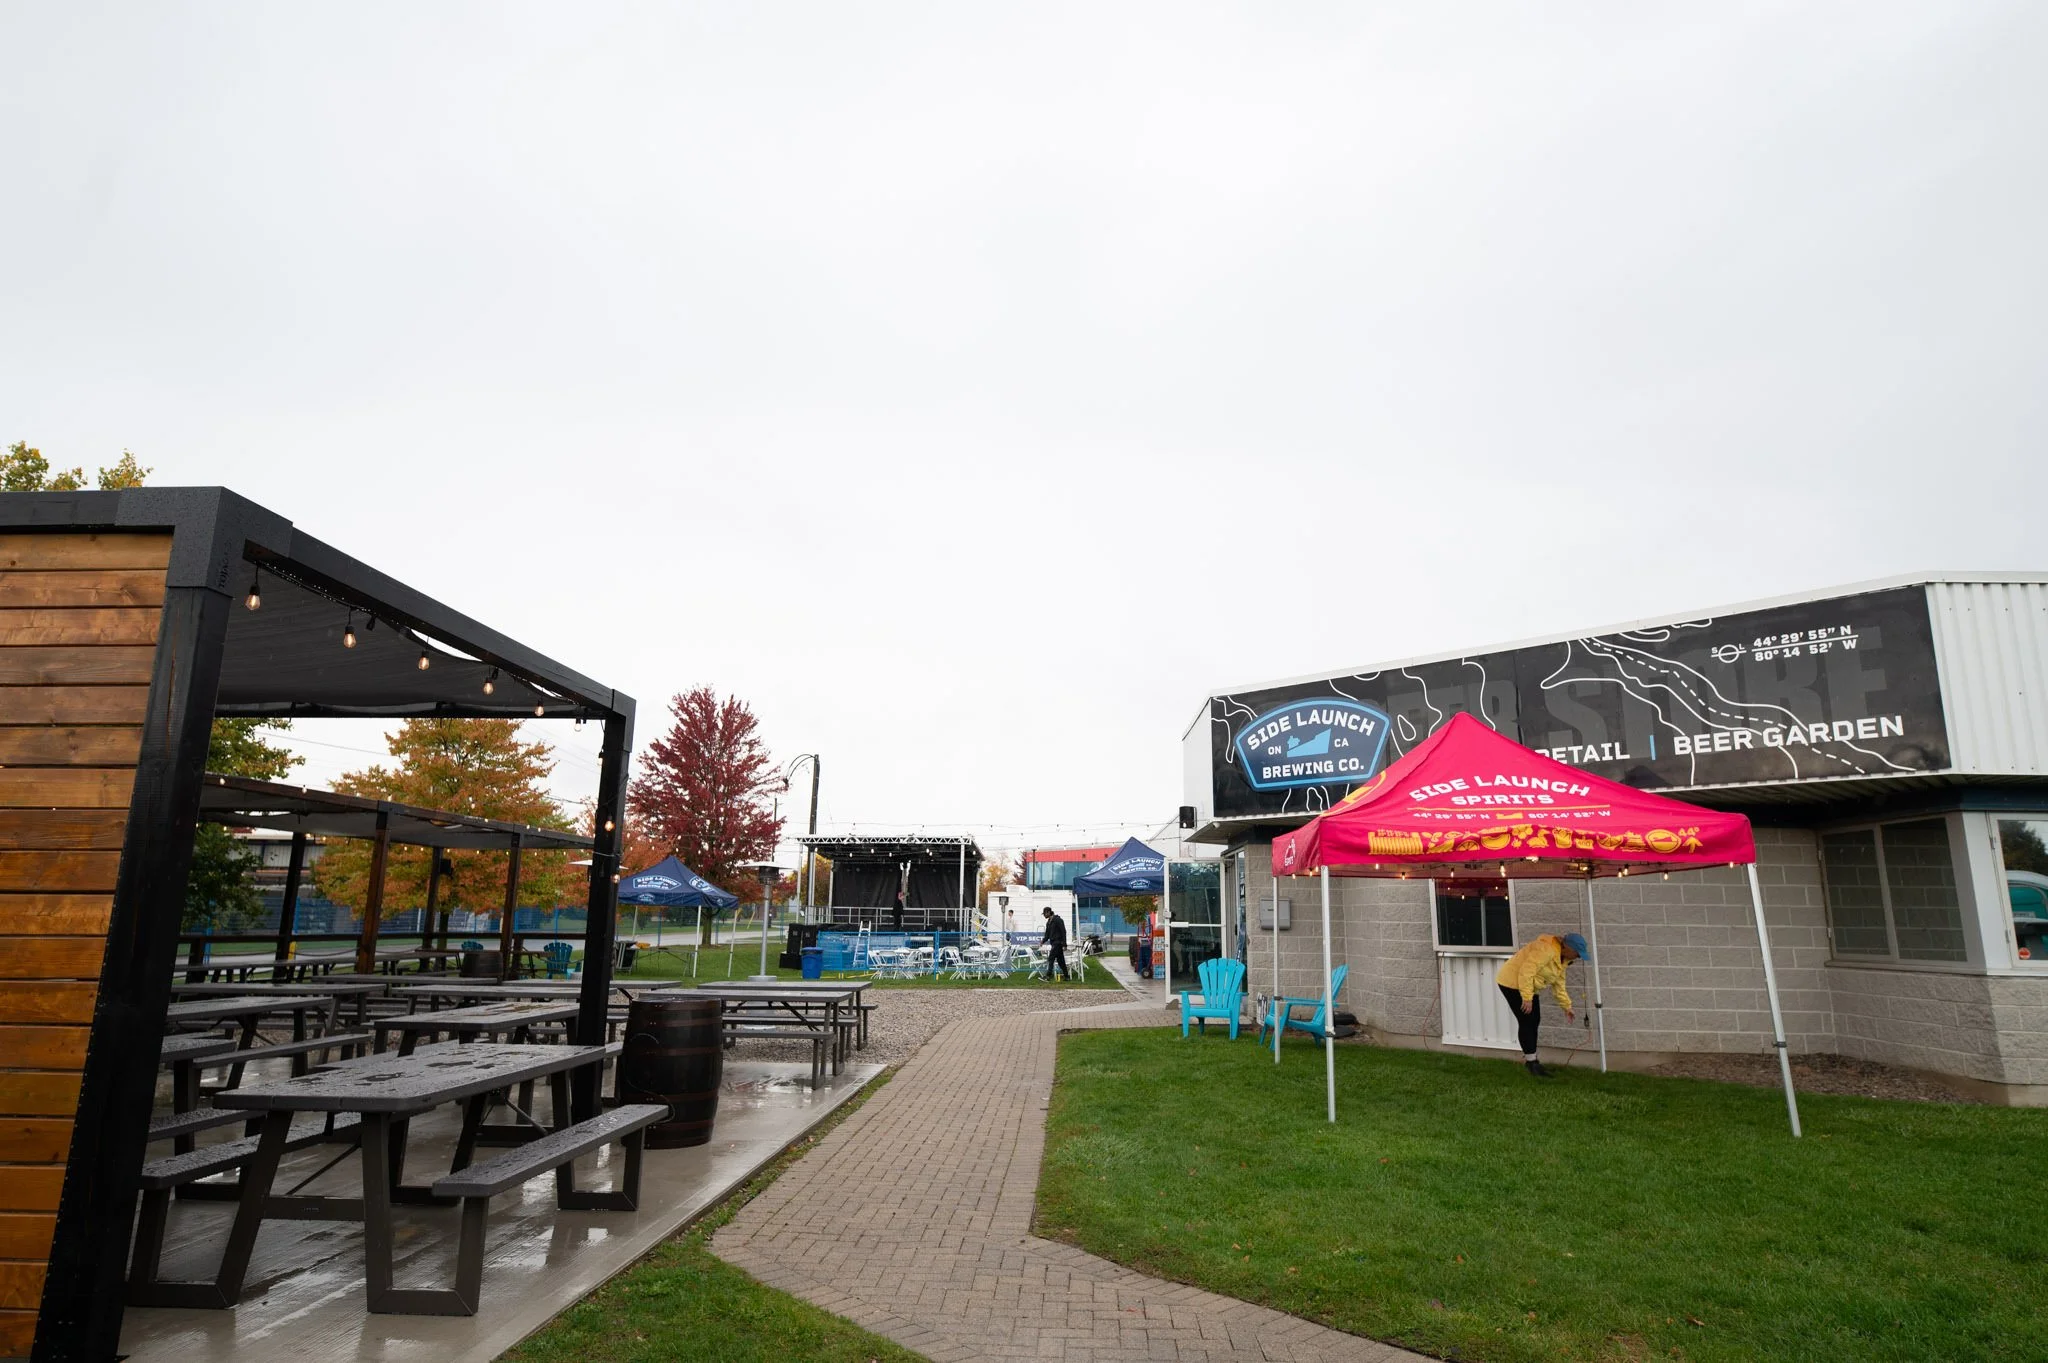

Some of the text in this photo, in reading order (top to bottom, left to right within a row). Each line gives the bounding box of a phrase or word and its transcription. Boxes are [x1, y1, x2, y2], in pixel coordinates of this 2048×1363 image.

[1753, 625, 1852, 648] 44° 29' 55" N
[1755, 638, 1857, 662] 80° 14 52' W
[1247, 709, 1375, 750] SIDE LAUNCH
[1673, 715, 1904, 756] BEER GARDEN
[1268, 737, 1349, 755] ON CA
[1262, 757, 1364, 779] BREWING CO.
[1409, 774, 1590, 802] SIDE LAUNCH
[1451, 794, 1555, 805] SPIRITS
[1678, 826, 1700, 837] 44°
